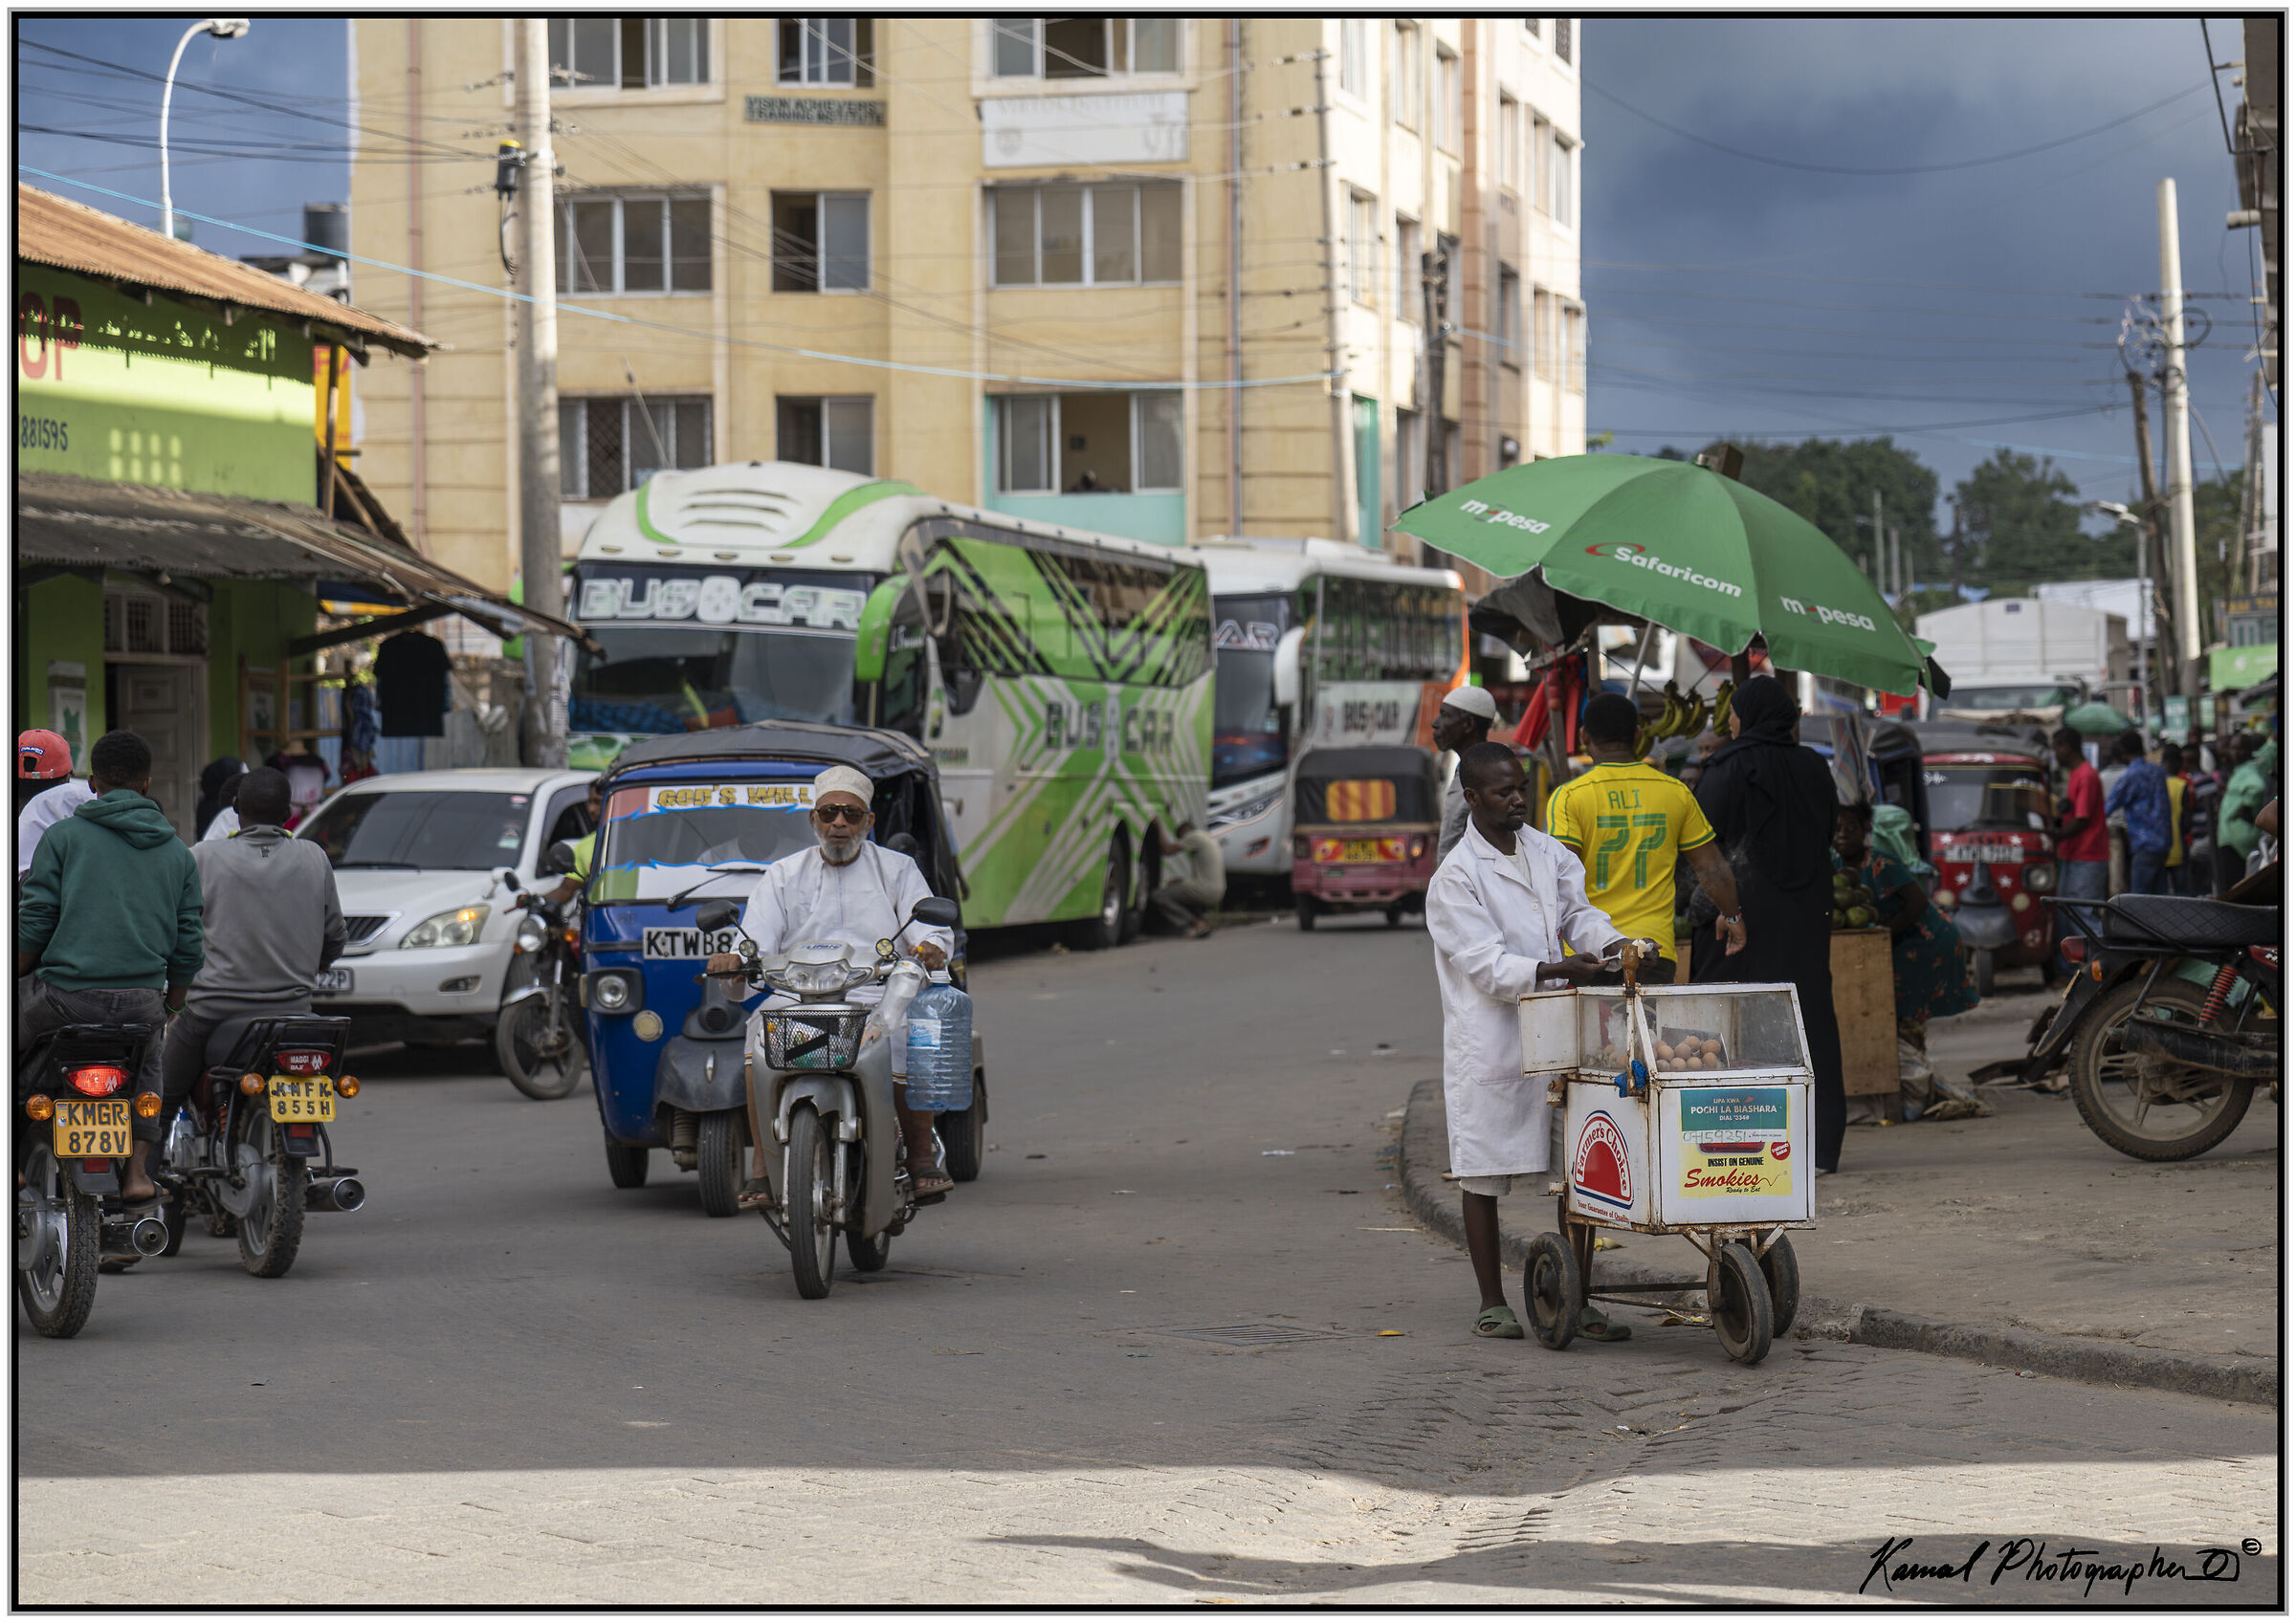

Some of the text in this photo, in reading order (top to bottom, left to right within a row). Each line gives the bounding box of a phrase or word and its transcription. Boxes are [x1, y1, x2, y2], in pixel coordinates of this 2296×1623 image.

[1614, 546, 1742, 598] Safaricom
[1047, 701, 1174, 754] BUS CAR
[657, 784, 812, 806] GOD'S WILL
[1608, 789, 1643, 809] ALI
[1596, 813, 1667, 890] 77
[68, 1103, 126, 1126] KMGR
[277, 1100, 330, 1116] 855H
[1690, 1106, 1718, 1114] POCHI
[1733, 1105, 1777, 1113] BIASHARA
[69, 1131, 126, 1153] 878V
[1577, 1123, 1627, 1192] Farmer's Choice
[1708, 1157, 1764, 1167] INSIST ON GENUINE
[1684, 1168, 1761, 1188] Smokies
[1578, 1199, 1587, 1209] Your
[1588, 1202, 1608, 1217] Guarantee
